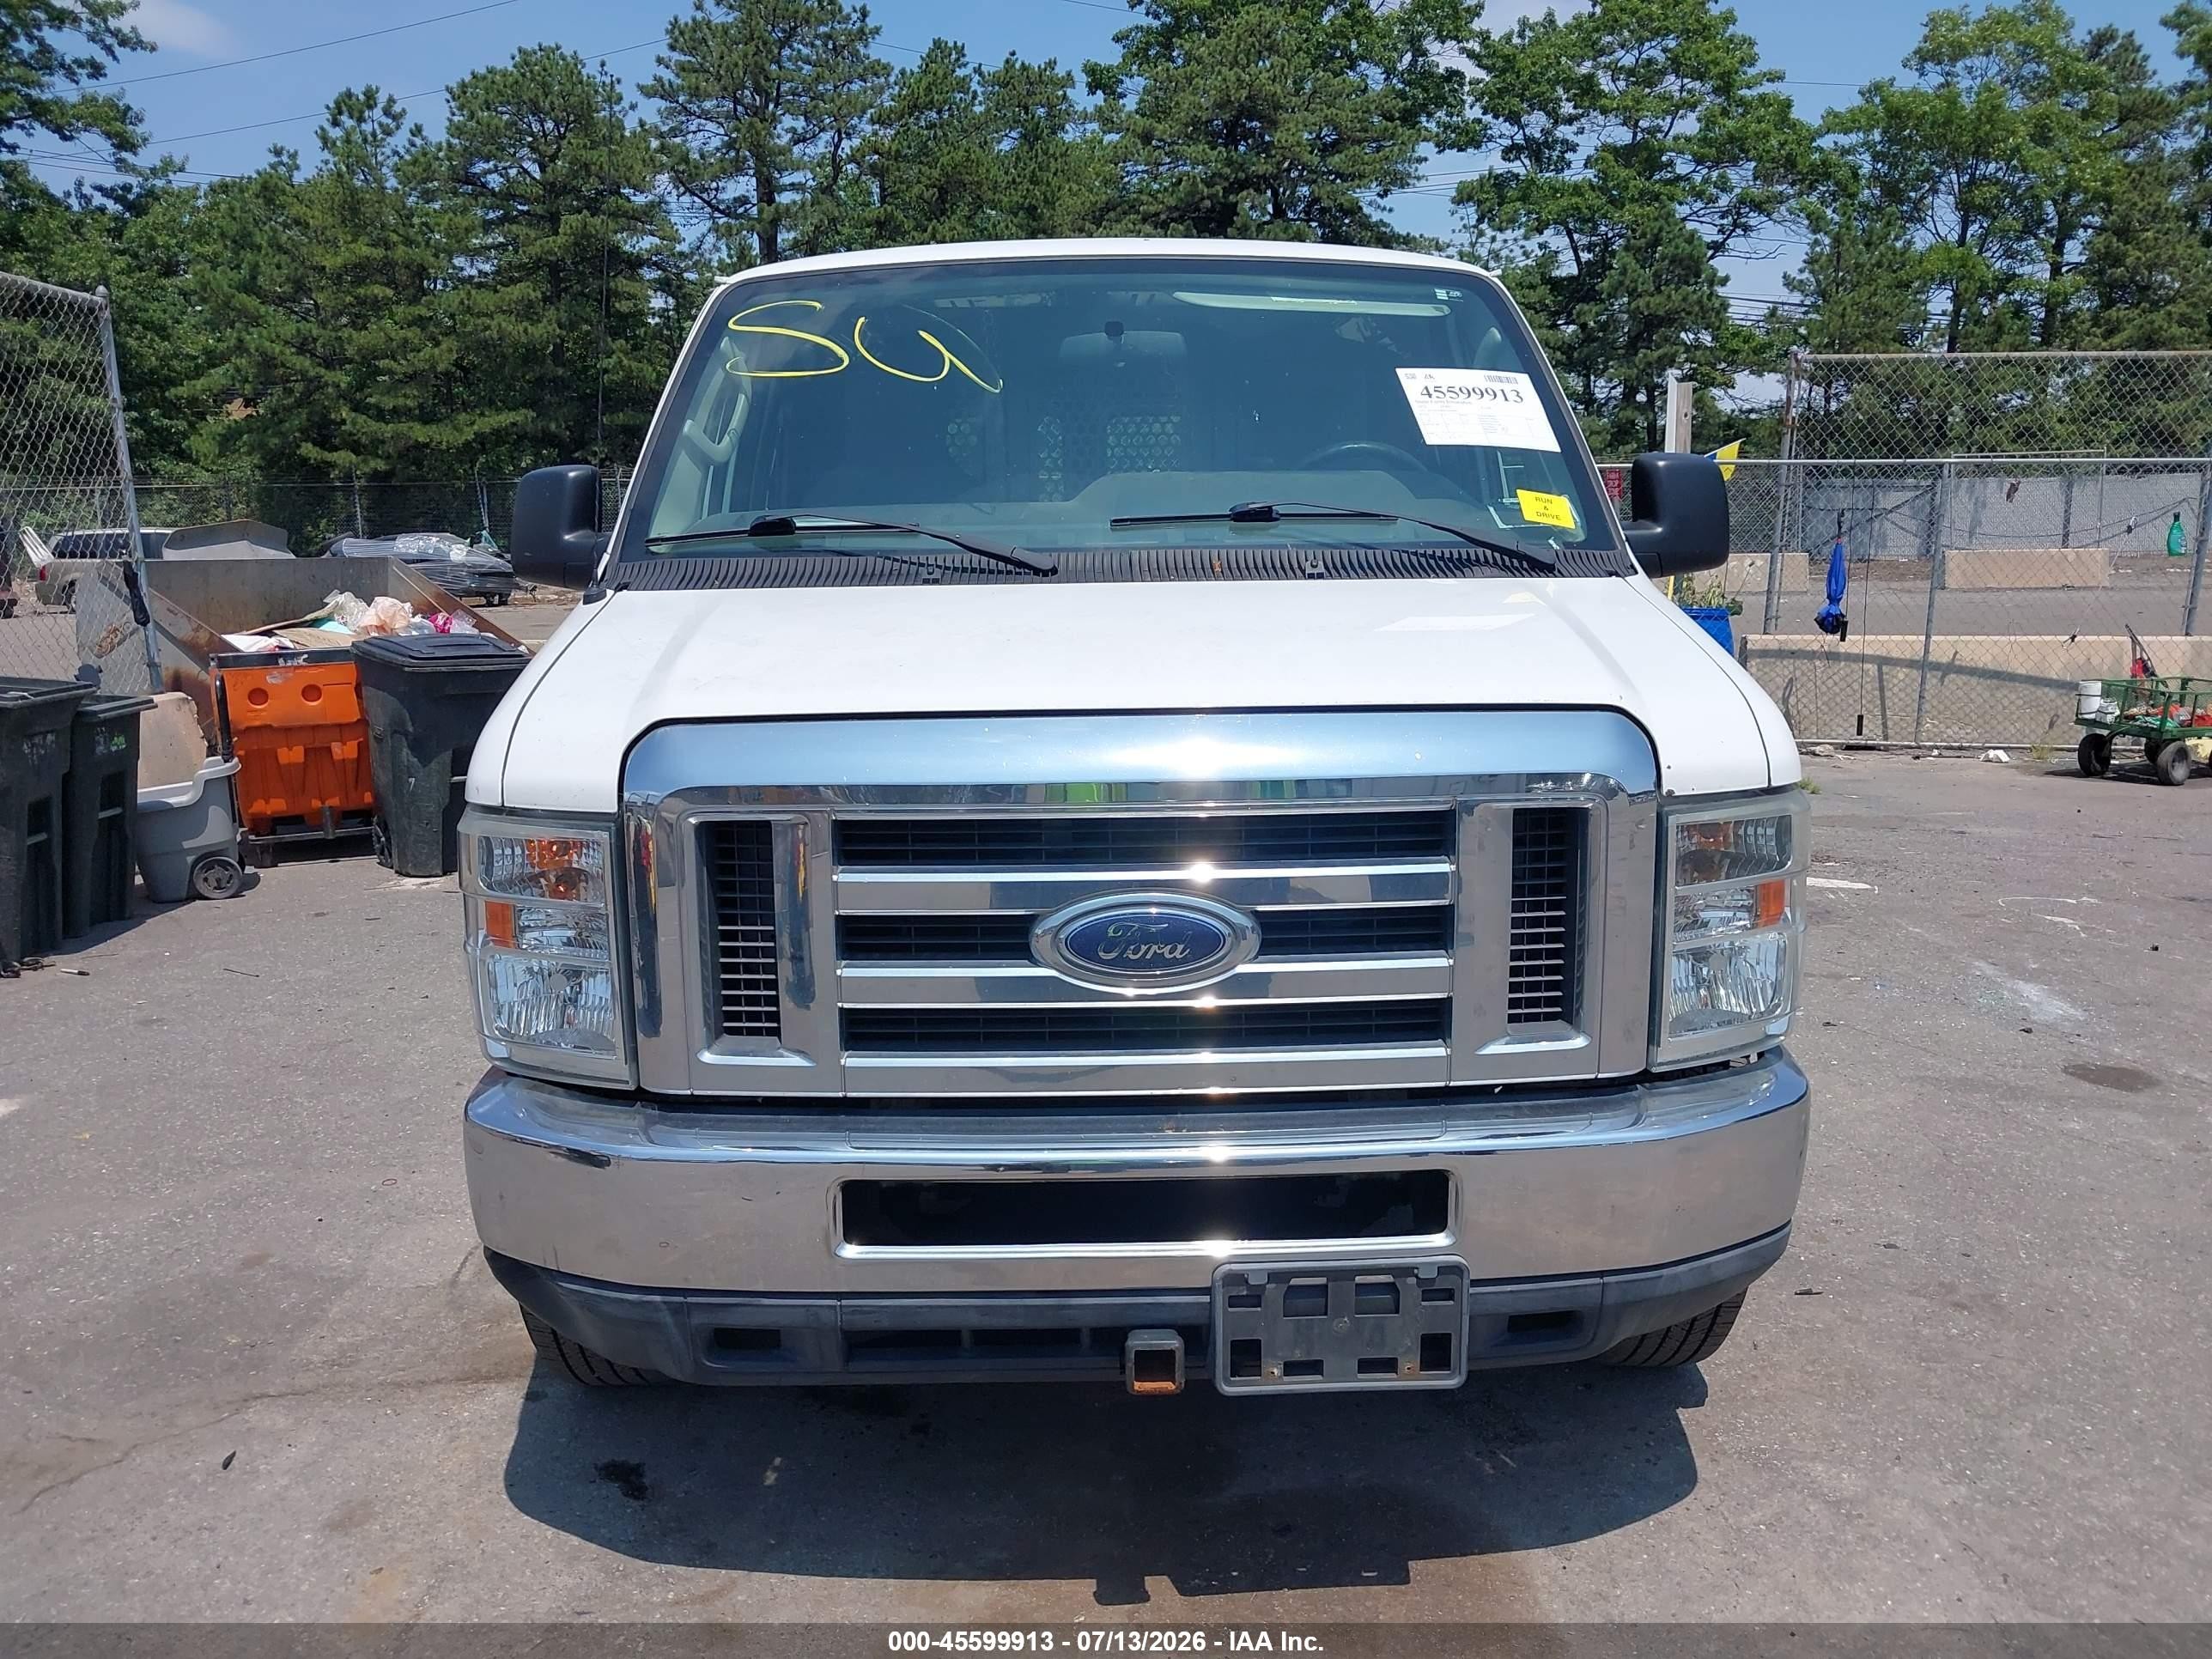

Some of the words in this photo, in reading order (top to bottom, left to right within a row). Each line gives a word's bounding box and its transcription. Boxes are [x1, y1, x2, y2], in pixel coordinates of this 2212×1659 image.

[1420, 385, 1524, 404] 45599913
[1534, 496, 1553, 505] RUN
[1535, 511, 1562, 520] DRIVE
[1097, 921, 1192, 960] Ford
